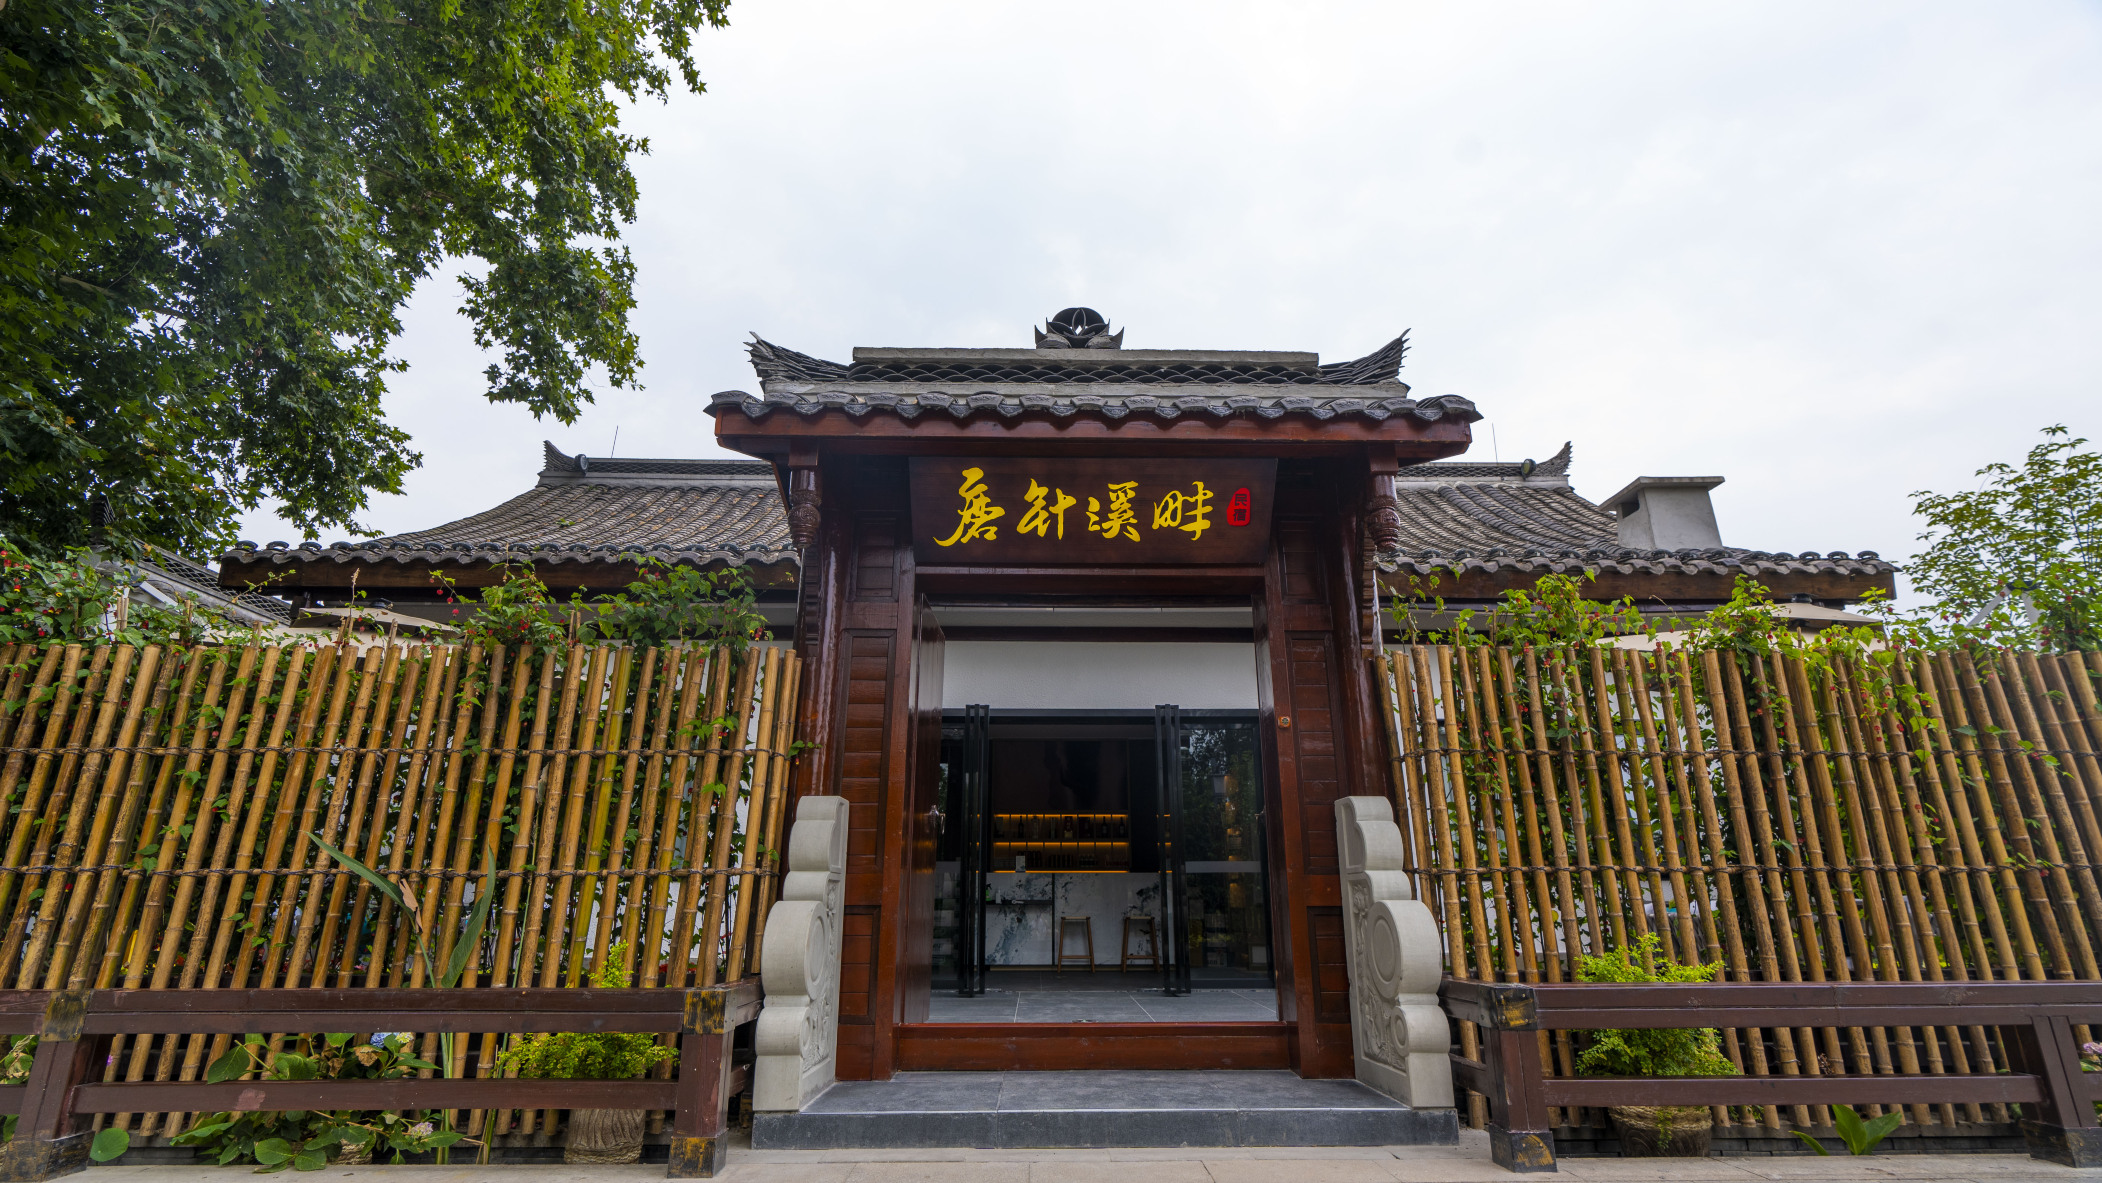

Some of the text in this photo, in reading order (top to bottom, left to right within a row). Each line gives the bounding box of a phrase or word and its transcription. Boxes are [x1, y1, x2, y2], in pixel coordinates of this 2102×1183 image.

[932, 467, 1214, 547] 磨针溪畔
[1233, 493, 1248, 522] 民宿
